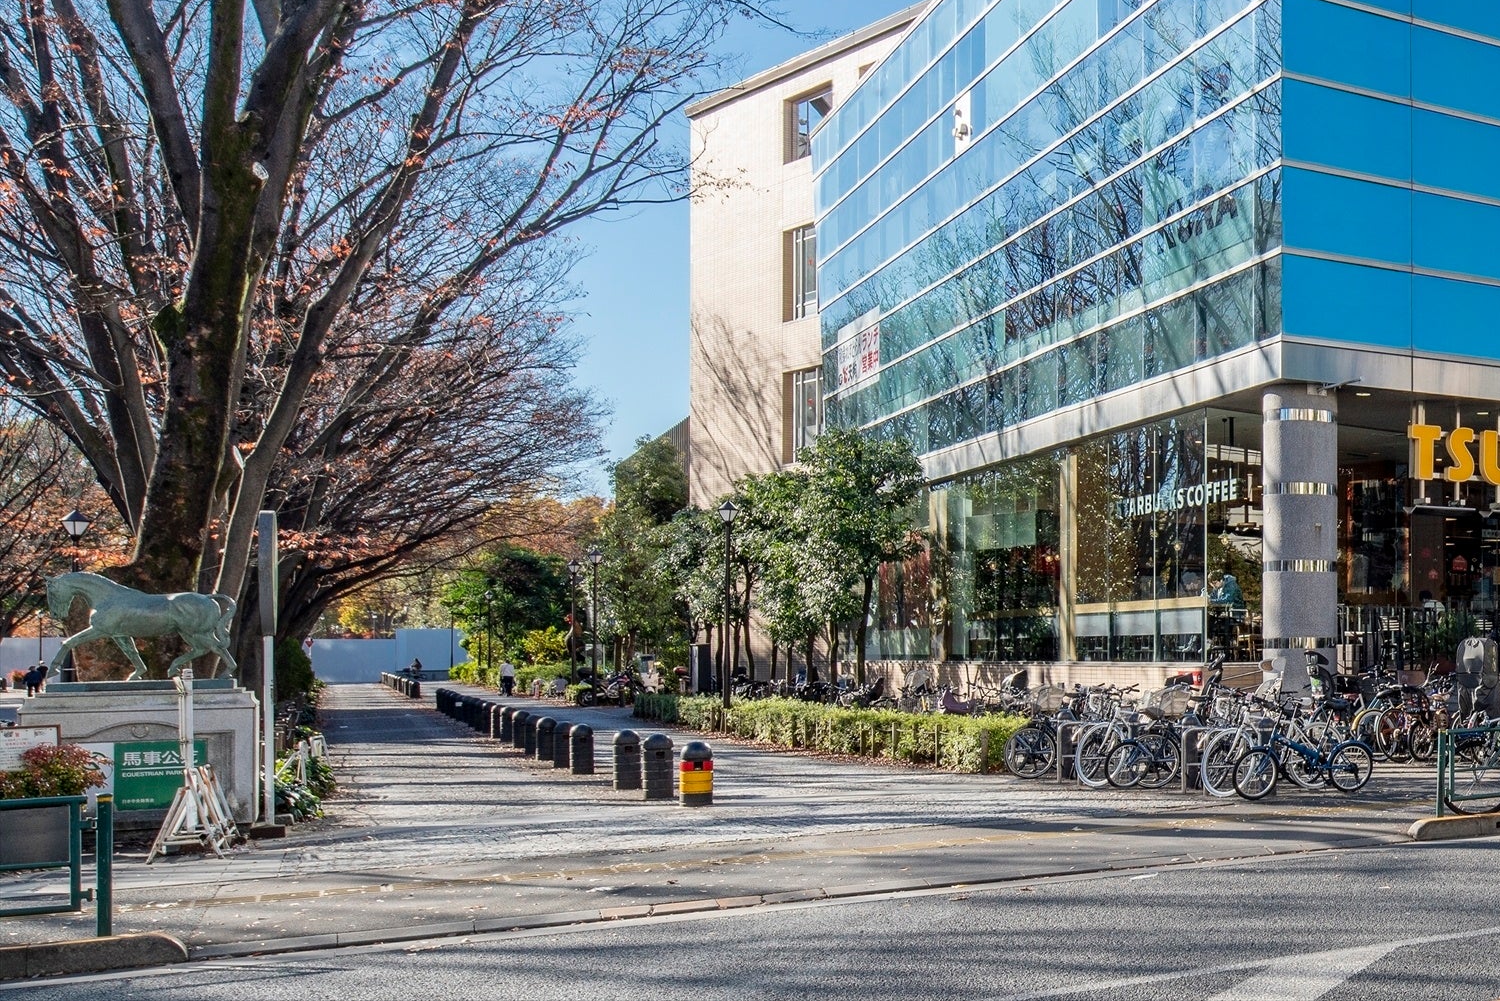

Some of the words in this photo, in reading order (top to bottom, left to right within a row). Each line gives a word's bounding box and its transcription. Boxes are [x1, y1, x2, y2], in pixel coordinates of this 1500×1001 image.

[1186, 478, 1237, 508] COFFEE
[121, 770, 164, 778] EQUESTRIAN
[165, 769, 183, 777] PARK
